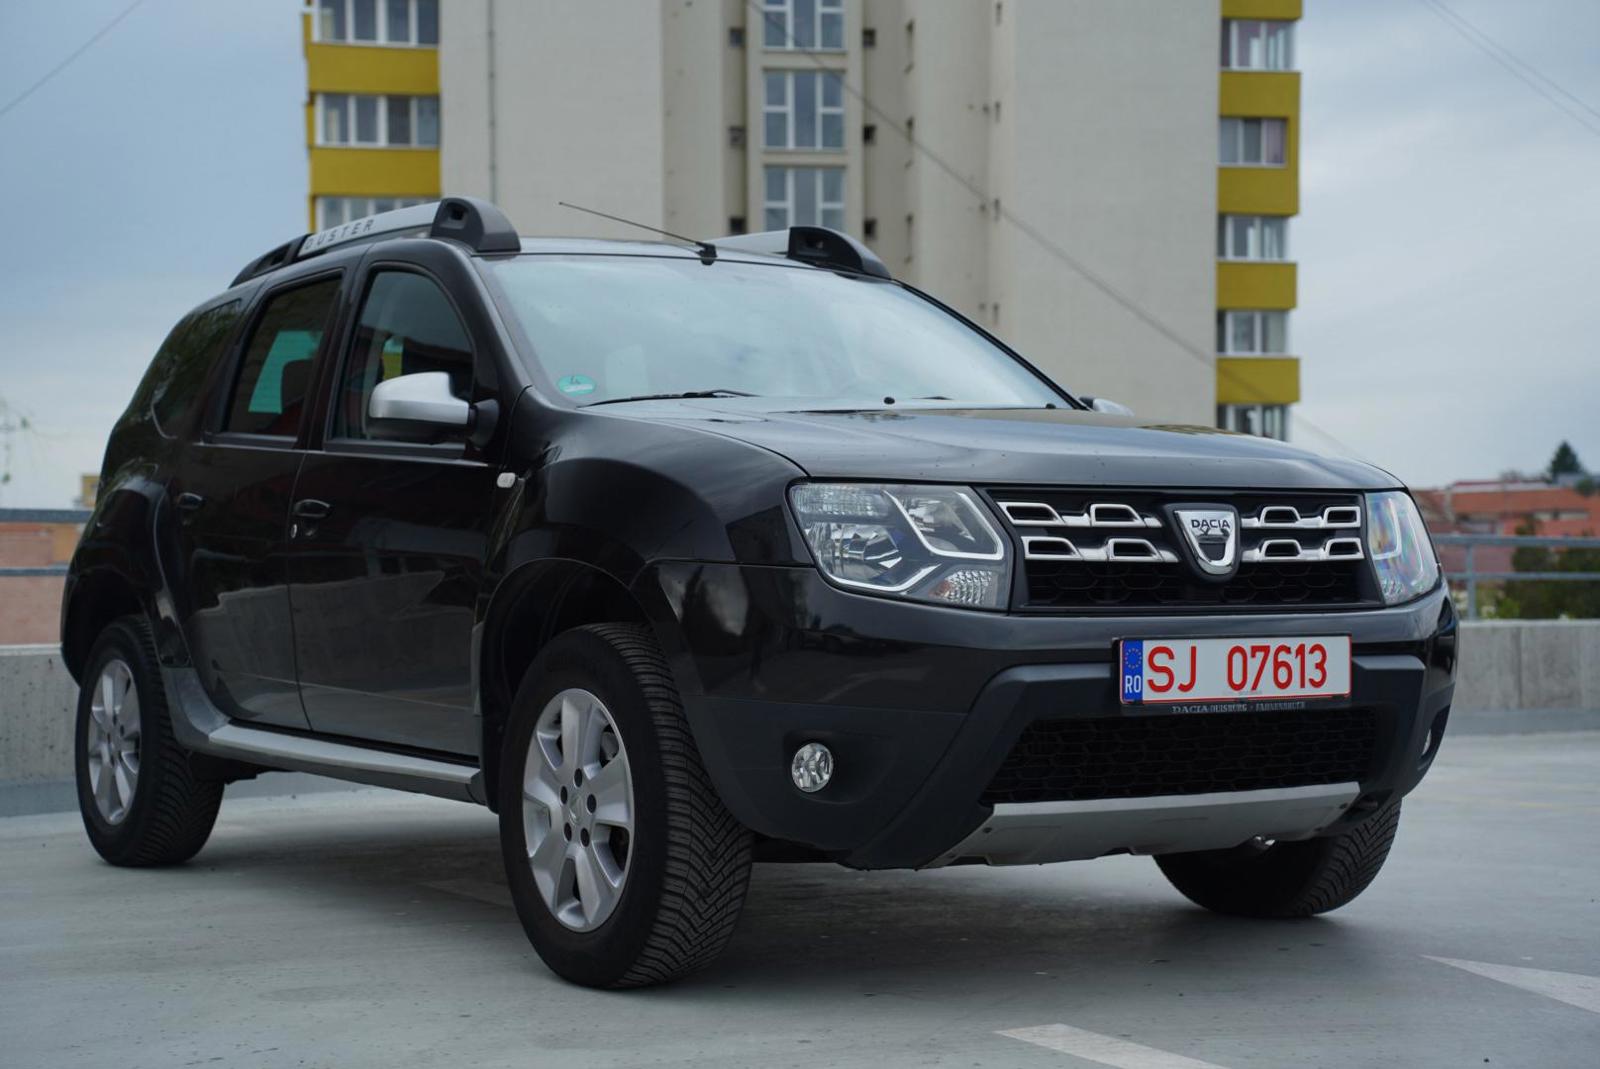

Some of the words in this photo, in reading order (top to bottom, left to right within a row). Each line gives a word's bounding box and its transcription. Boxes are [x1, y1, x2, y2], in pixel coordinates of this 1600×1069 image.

[304, 219, 375, 250] DUSTER
[1191, 519, 1230, 528] DACIA
[1147, 645, 1197, 693] SJ
[1227, 643, 1327, 691] 07613
[1125, 675, 1142, 694] RO
